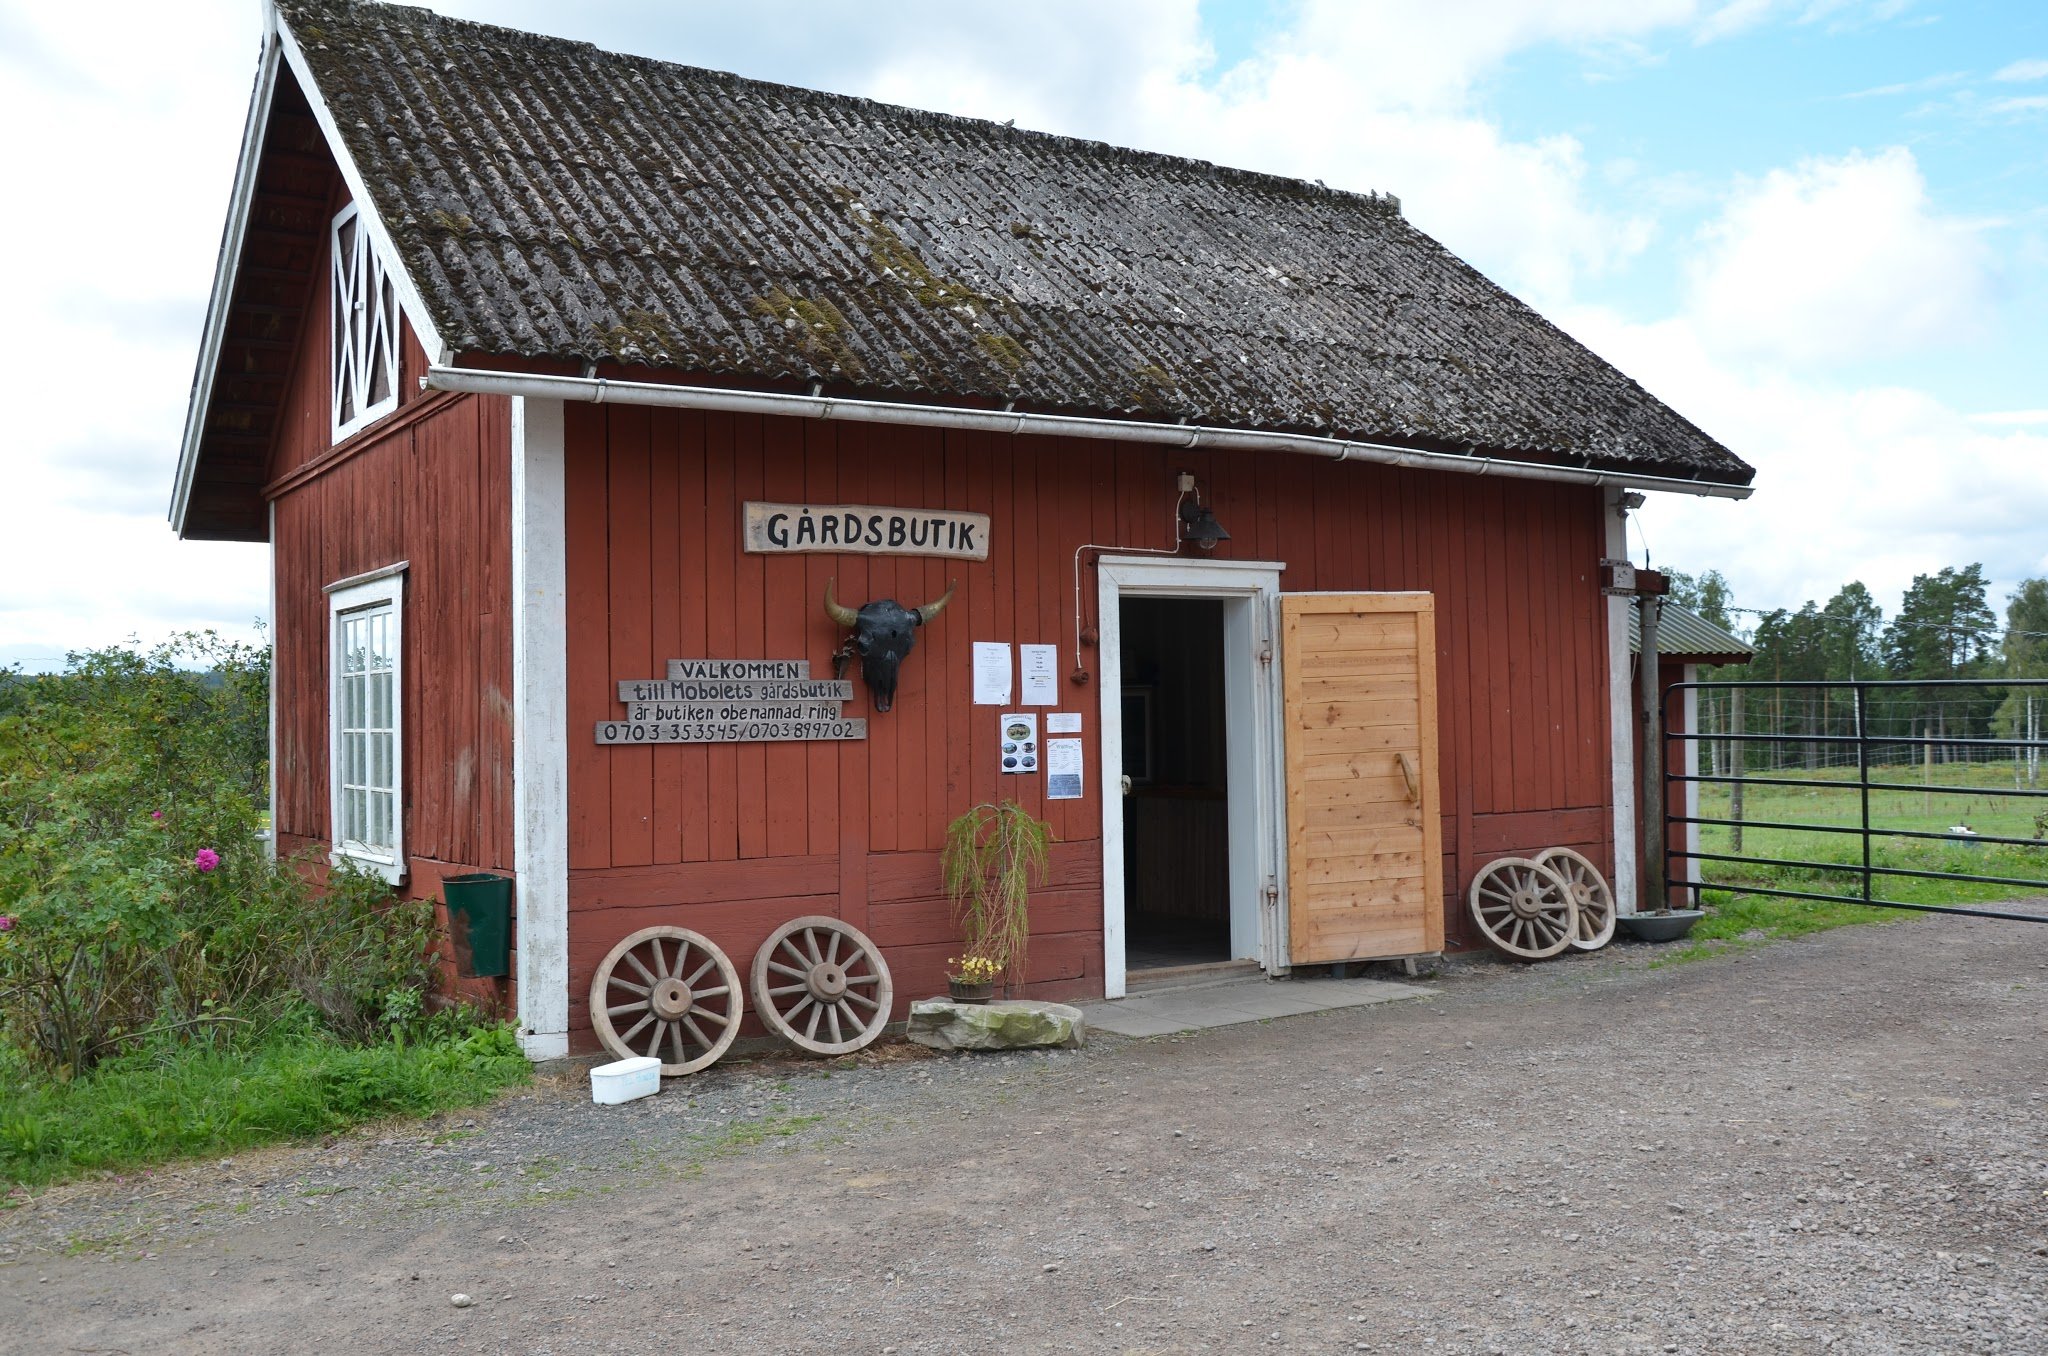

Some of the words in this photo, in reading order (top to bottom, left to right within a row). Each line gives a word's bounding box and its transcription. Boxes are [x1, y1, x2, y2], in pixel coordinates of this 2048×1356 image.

[767, 508, 975, 551] GÅRDSBUTIK
[680, 662, 799, 679] VÄLKOMMEN
[633, 683, 665, 700] till
[671, 681, 753, 700] Mobolets
[760, 681, 842, 700] gårdsbutik
[634, 703, 650, 720] är
[656, 704, 714, 720] butiken
[808, 704, 836, 720] ring
